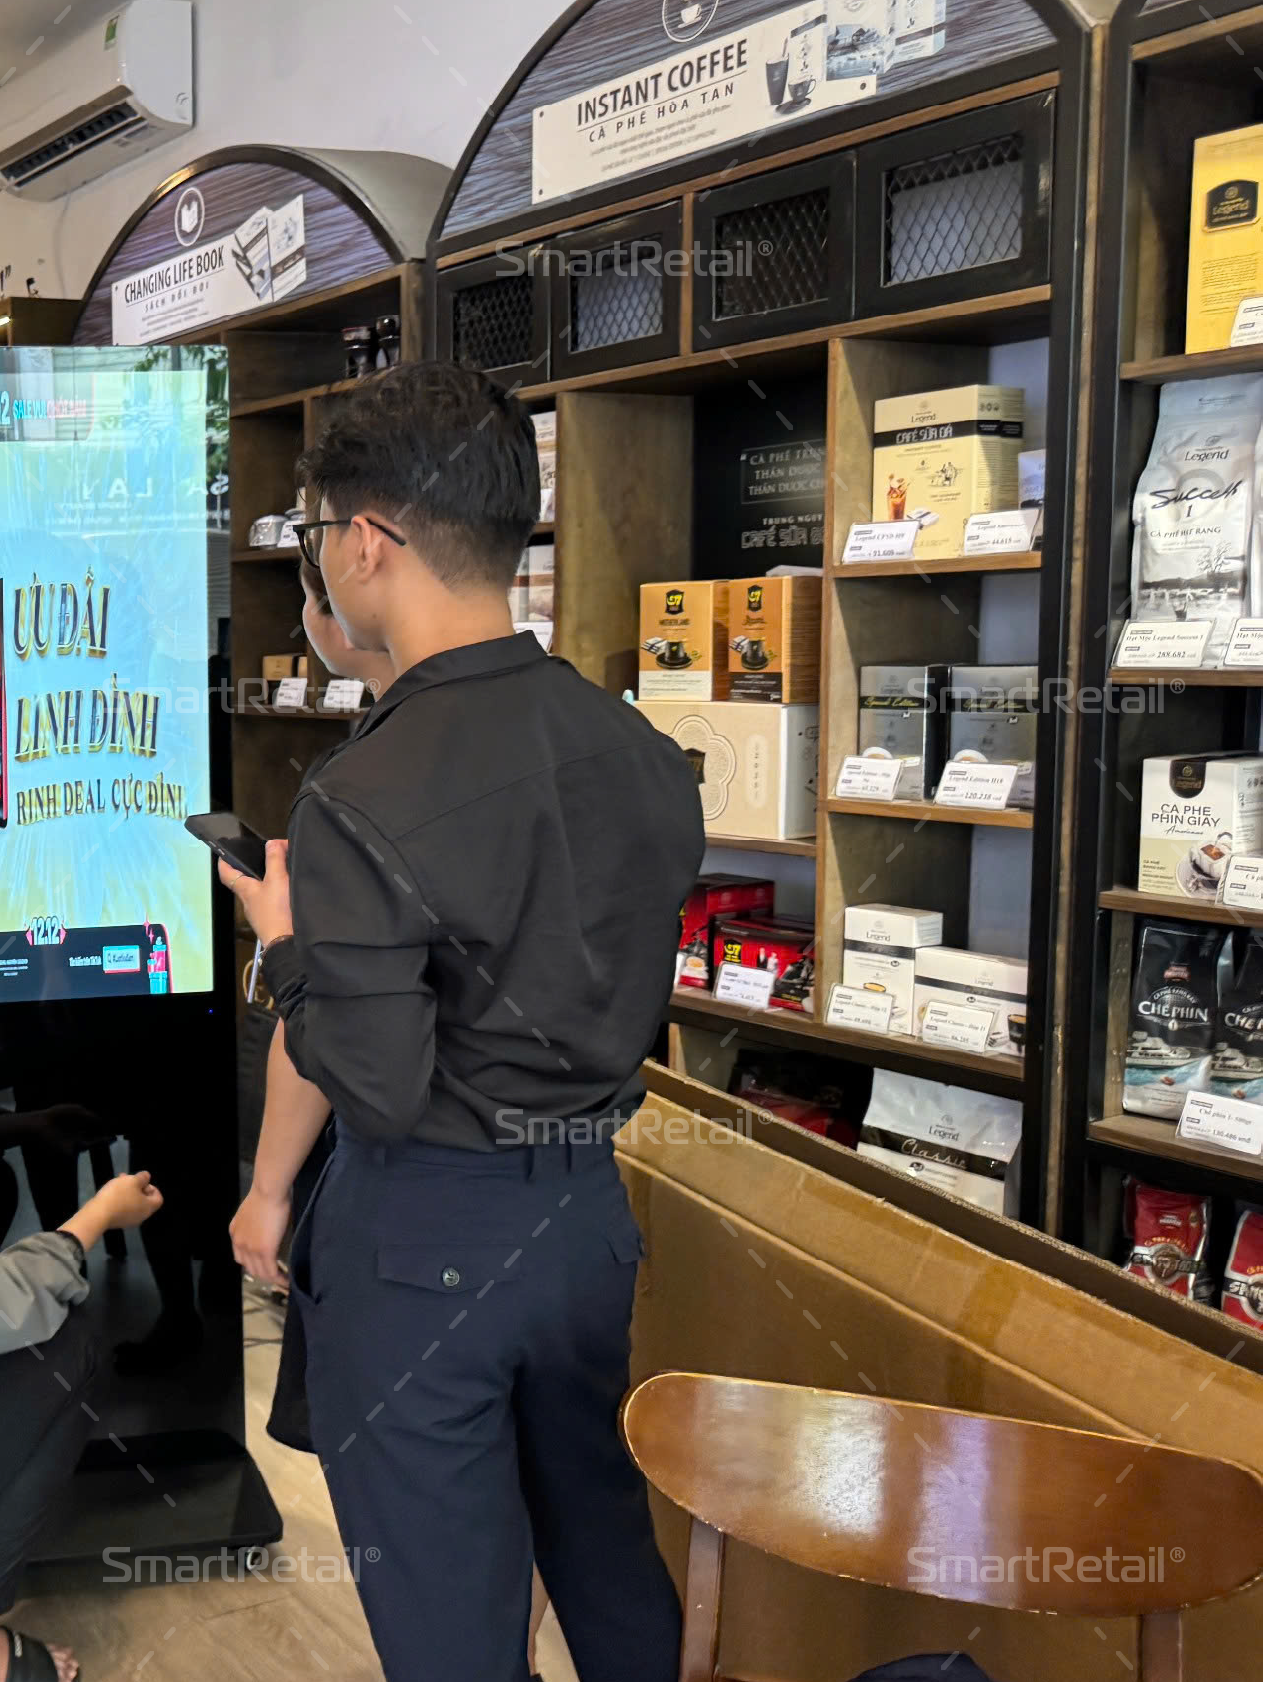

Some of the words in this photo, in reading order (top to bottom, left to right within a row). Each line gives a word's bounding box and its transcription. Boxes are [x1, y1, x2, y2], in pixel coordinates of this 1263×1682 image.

[577, 72, 662, 126] INSTANT
[667, 39, 748, 92] COFFEE
[589, 125, 605, 142] CÀ
[616, 110, 647, 133] PHÊ
[657, 99, 688, 119] HÒA
[701, 82, 734, 104] TAN
[124, 267, 171, 304] CHANGING
[173, 257, 193, 285] LIFE
[196, 245, 224, 277] BOOK
[1184, 448, 1230, 462] Legend
[1195, 526, 1222, 535] RANG
[16, 783, 61, 826] RINH
[64, 778, 106, 816] DEAL
[1151, 812, 1184, 825] PHIN
[31, 914, 60, 946] 12.12
[866, 931, 891, 942] Legend
[1171, 1005, 1209, 1023] PHIN
[928, 1125, 960, 1142] Legend
[901, 1137, 968, 1170] Classic
